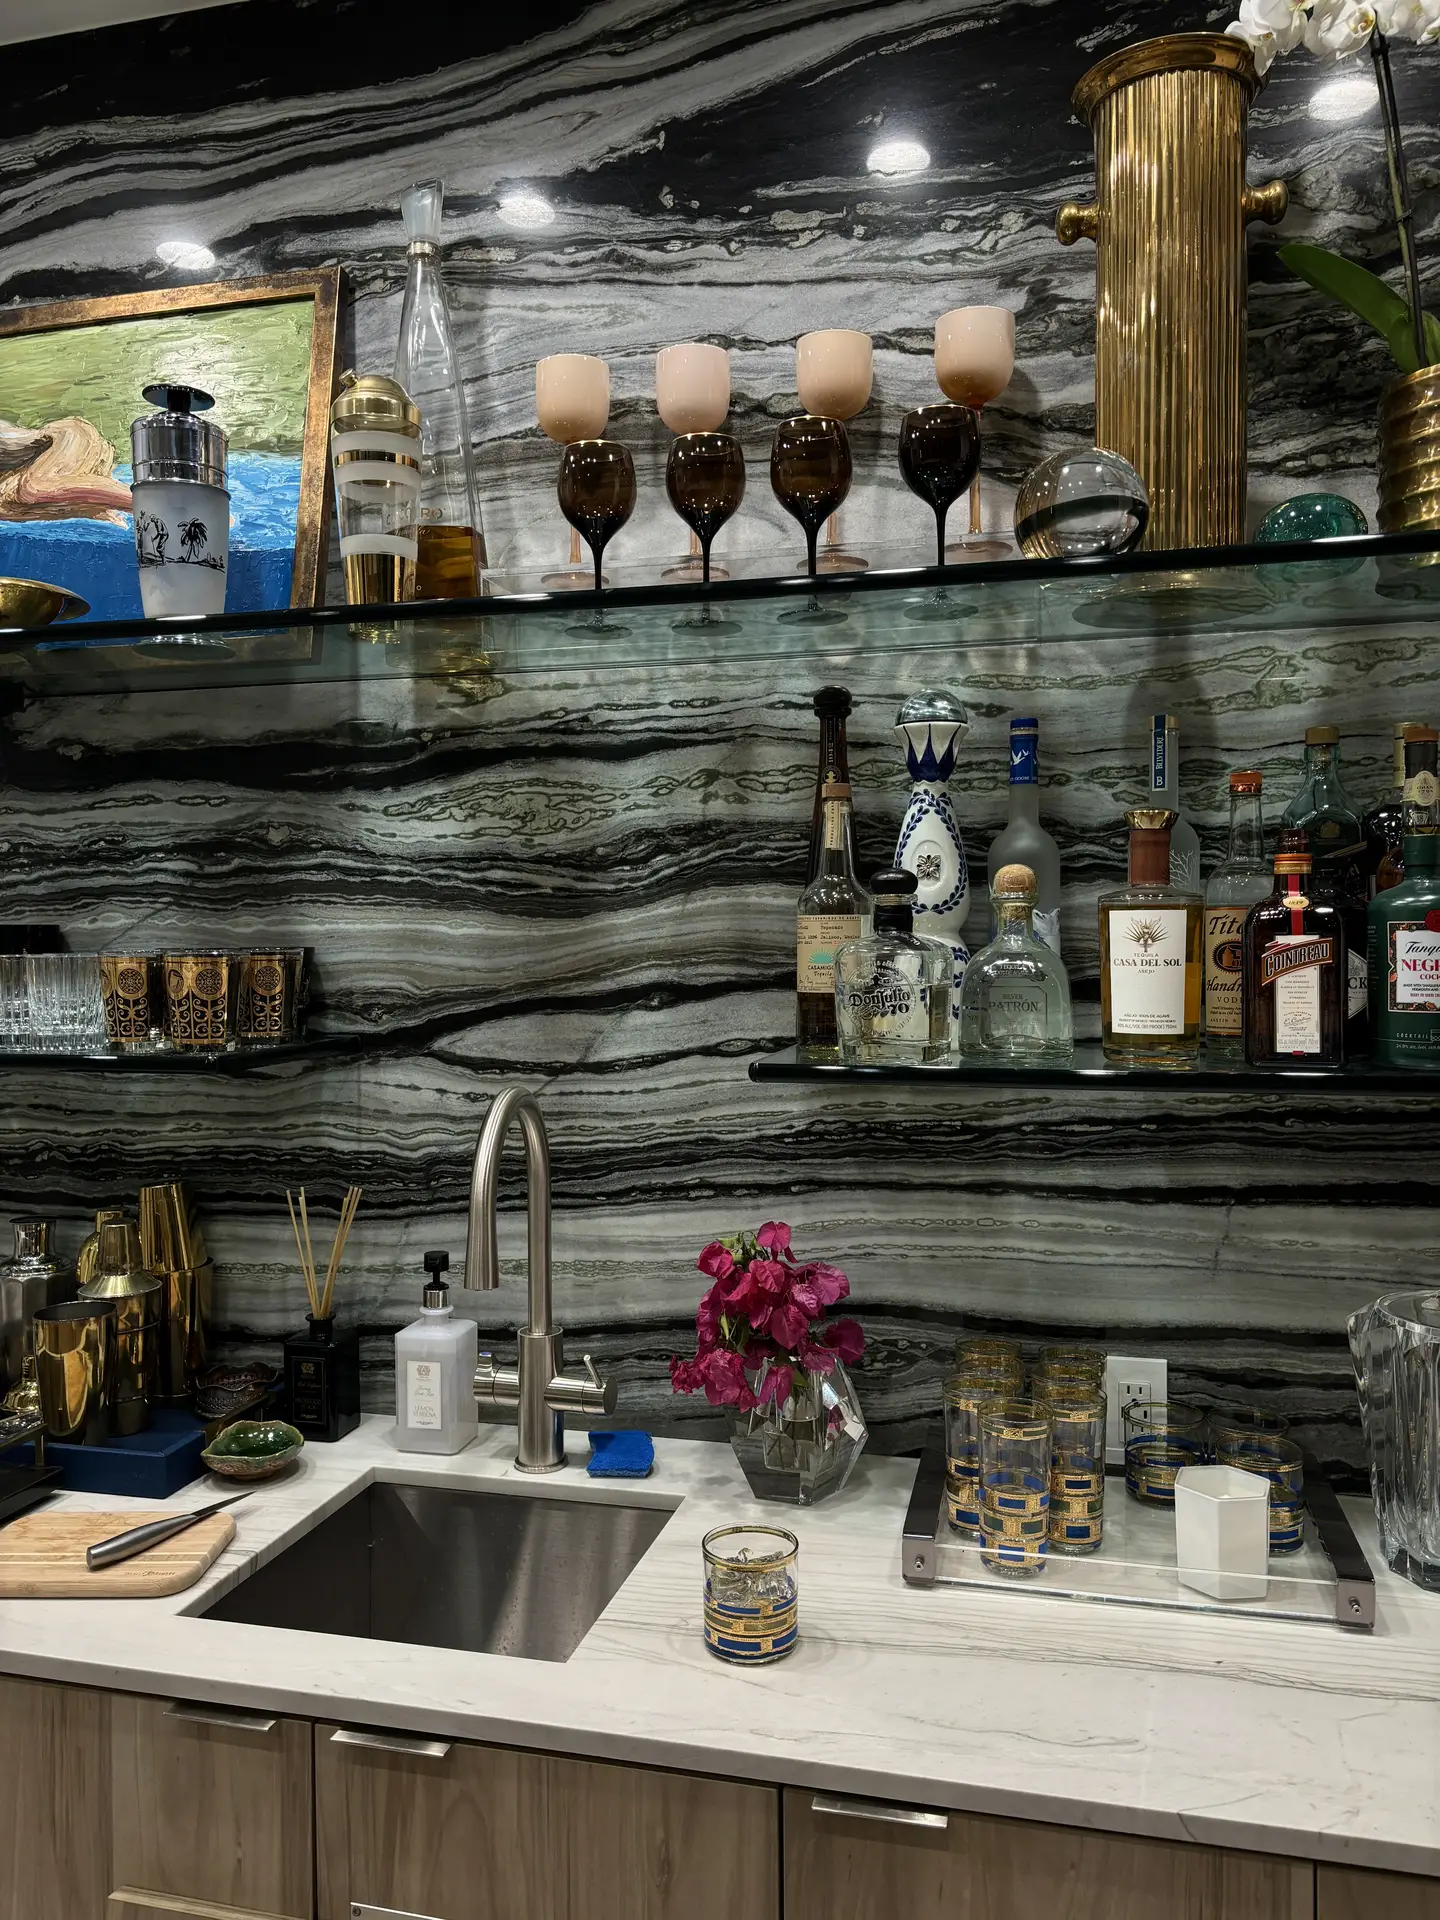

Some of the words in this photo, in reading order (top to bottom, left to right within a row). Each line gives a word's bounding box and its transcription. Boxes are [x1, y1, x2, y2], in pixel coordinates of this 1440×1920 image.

[1155, 736, 1164, 770] BELVEDERE
[1113, 958, 1138, 967] CASA
[1140, 958, 1161, 967] DEL
[1163, 958, 1182, 967] SOL
[1264, 942, 1330, 979] COINTREAU
[887, 1002, 910, 1016] 70
[988, 998, 1038, 1012] PATRÓN
